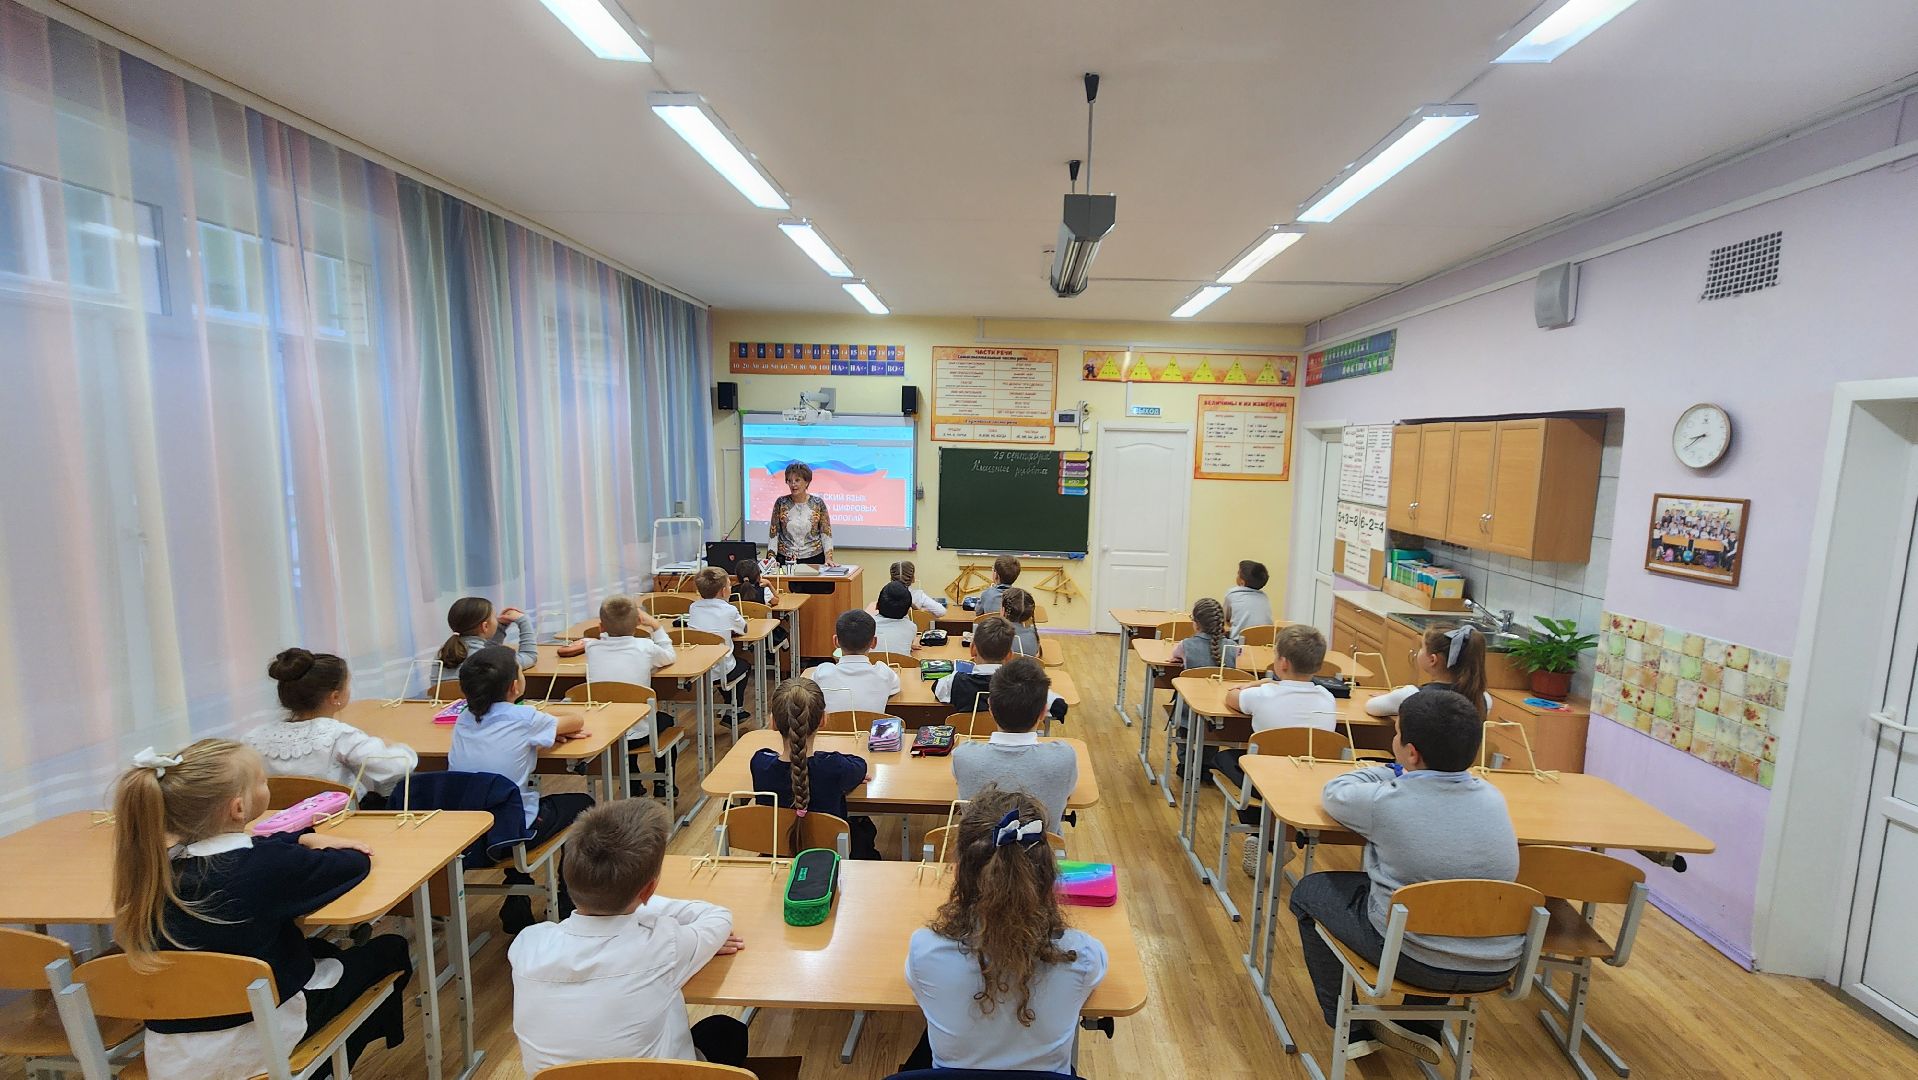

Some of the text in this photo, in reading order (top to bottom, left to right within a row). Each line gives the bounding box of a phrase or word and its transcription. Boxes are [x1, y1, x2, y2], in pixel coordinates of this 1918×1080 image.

[1132, 407, 1160, 416] ВЫХОД
[832, 503, 877, 513] ЦИФРОВЫХ
[1338, 511, 1358, 527] 5+3=8
[1360, 516, 1384, 533] 6-2=4
